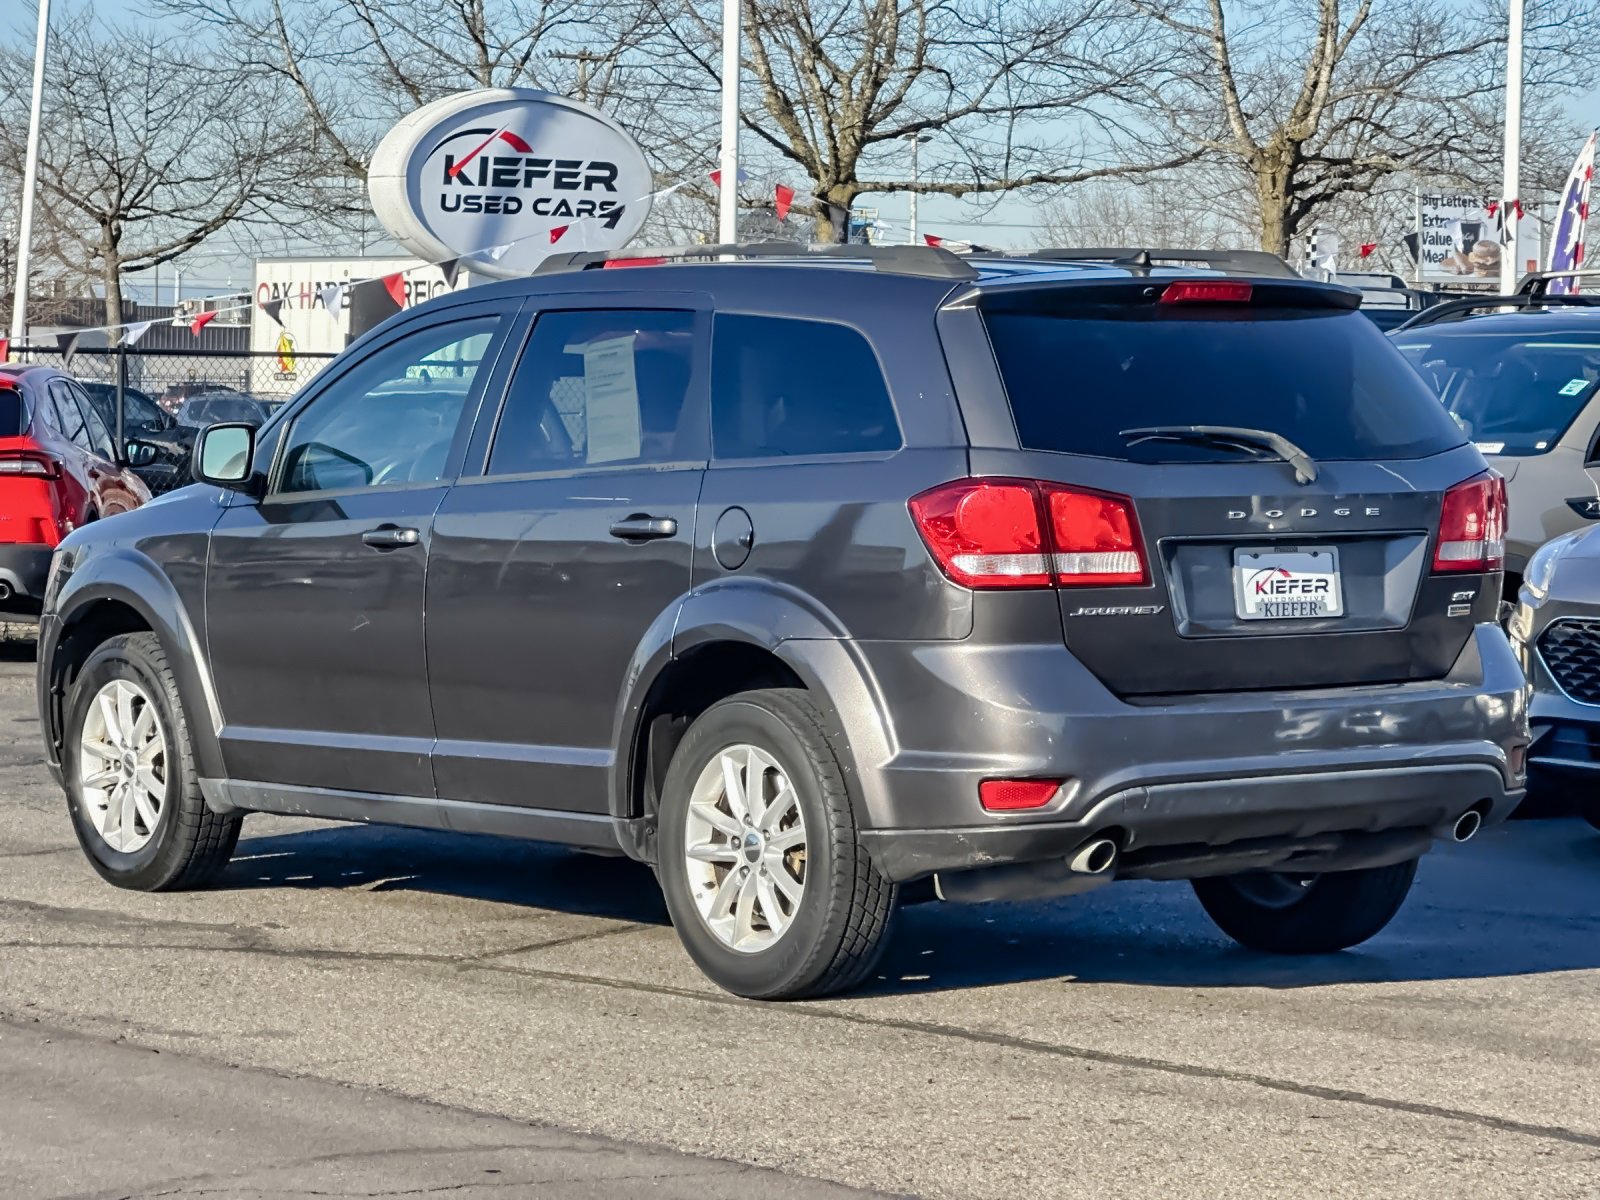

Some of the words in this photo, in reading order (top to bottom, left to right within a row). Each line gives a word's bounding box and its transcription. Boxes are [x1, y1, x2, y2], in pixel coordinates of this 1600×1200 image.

[443, 154, 618, 193] KIEFER
[440, 193, 522, 215] USED
[1422, 194, 1438, 210] Big
[1422, 231, 1453, 246] Value
[1422, 249, 1448, 263] Meal
[257, 282, 293, 309] OAK
[1228, 508, 1380, 519] DODGE
[1256, 578, 1329, 595] KIEFER
[1070, 605, 1165, 616] JOURNEY
[1264, 602, 1318, 617] KIEFER
